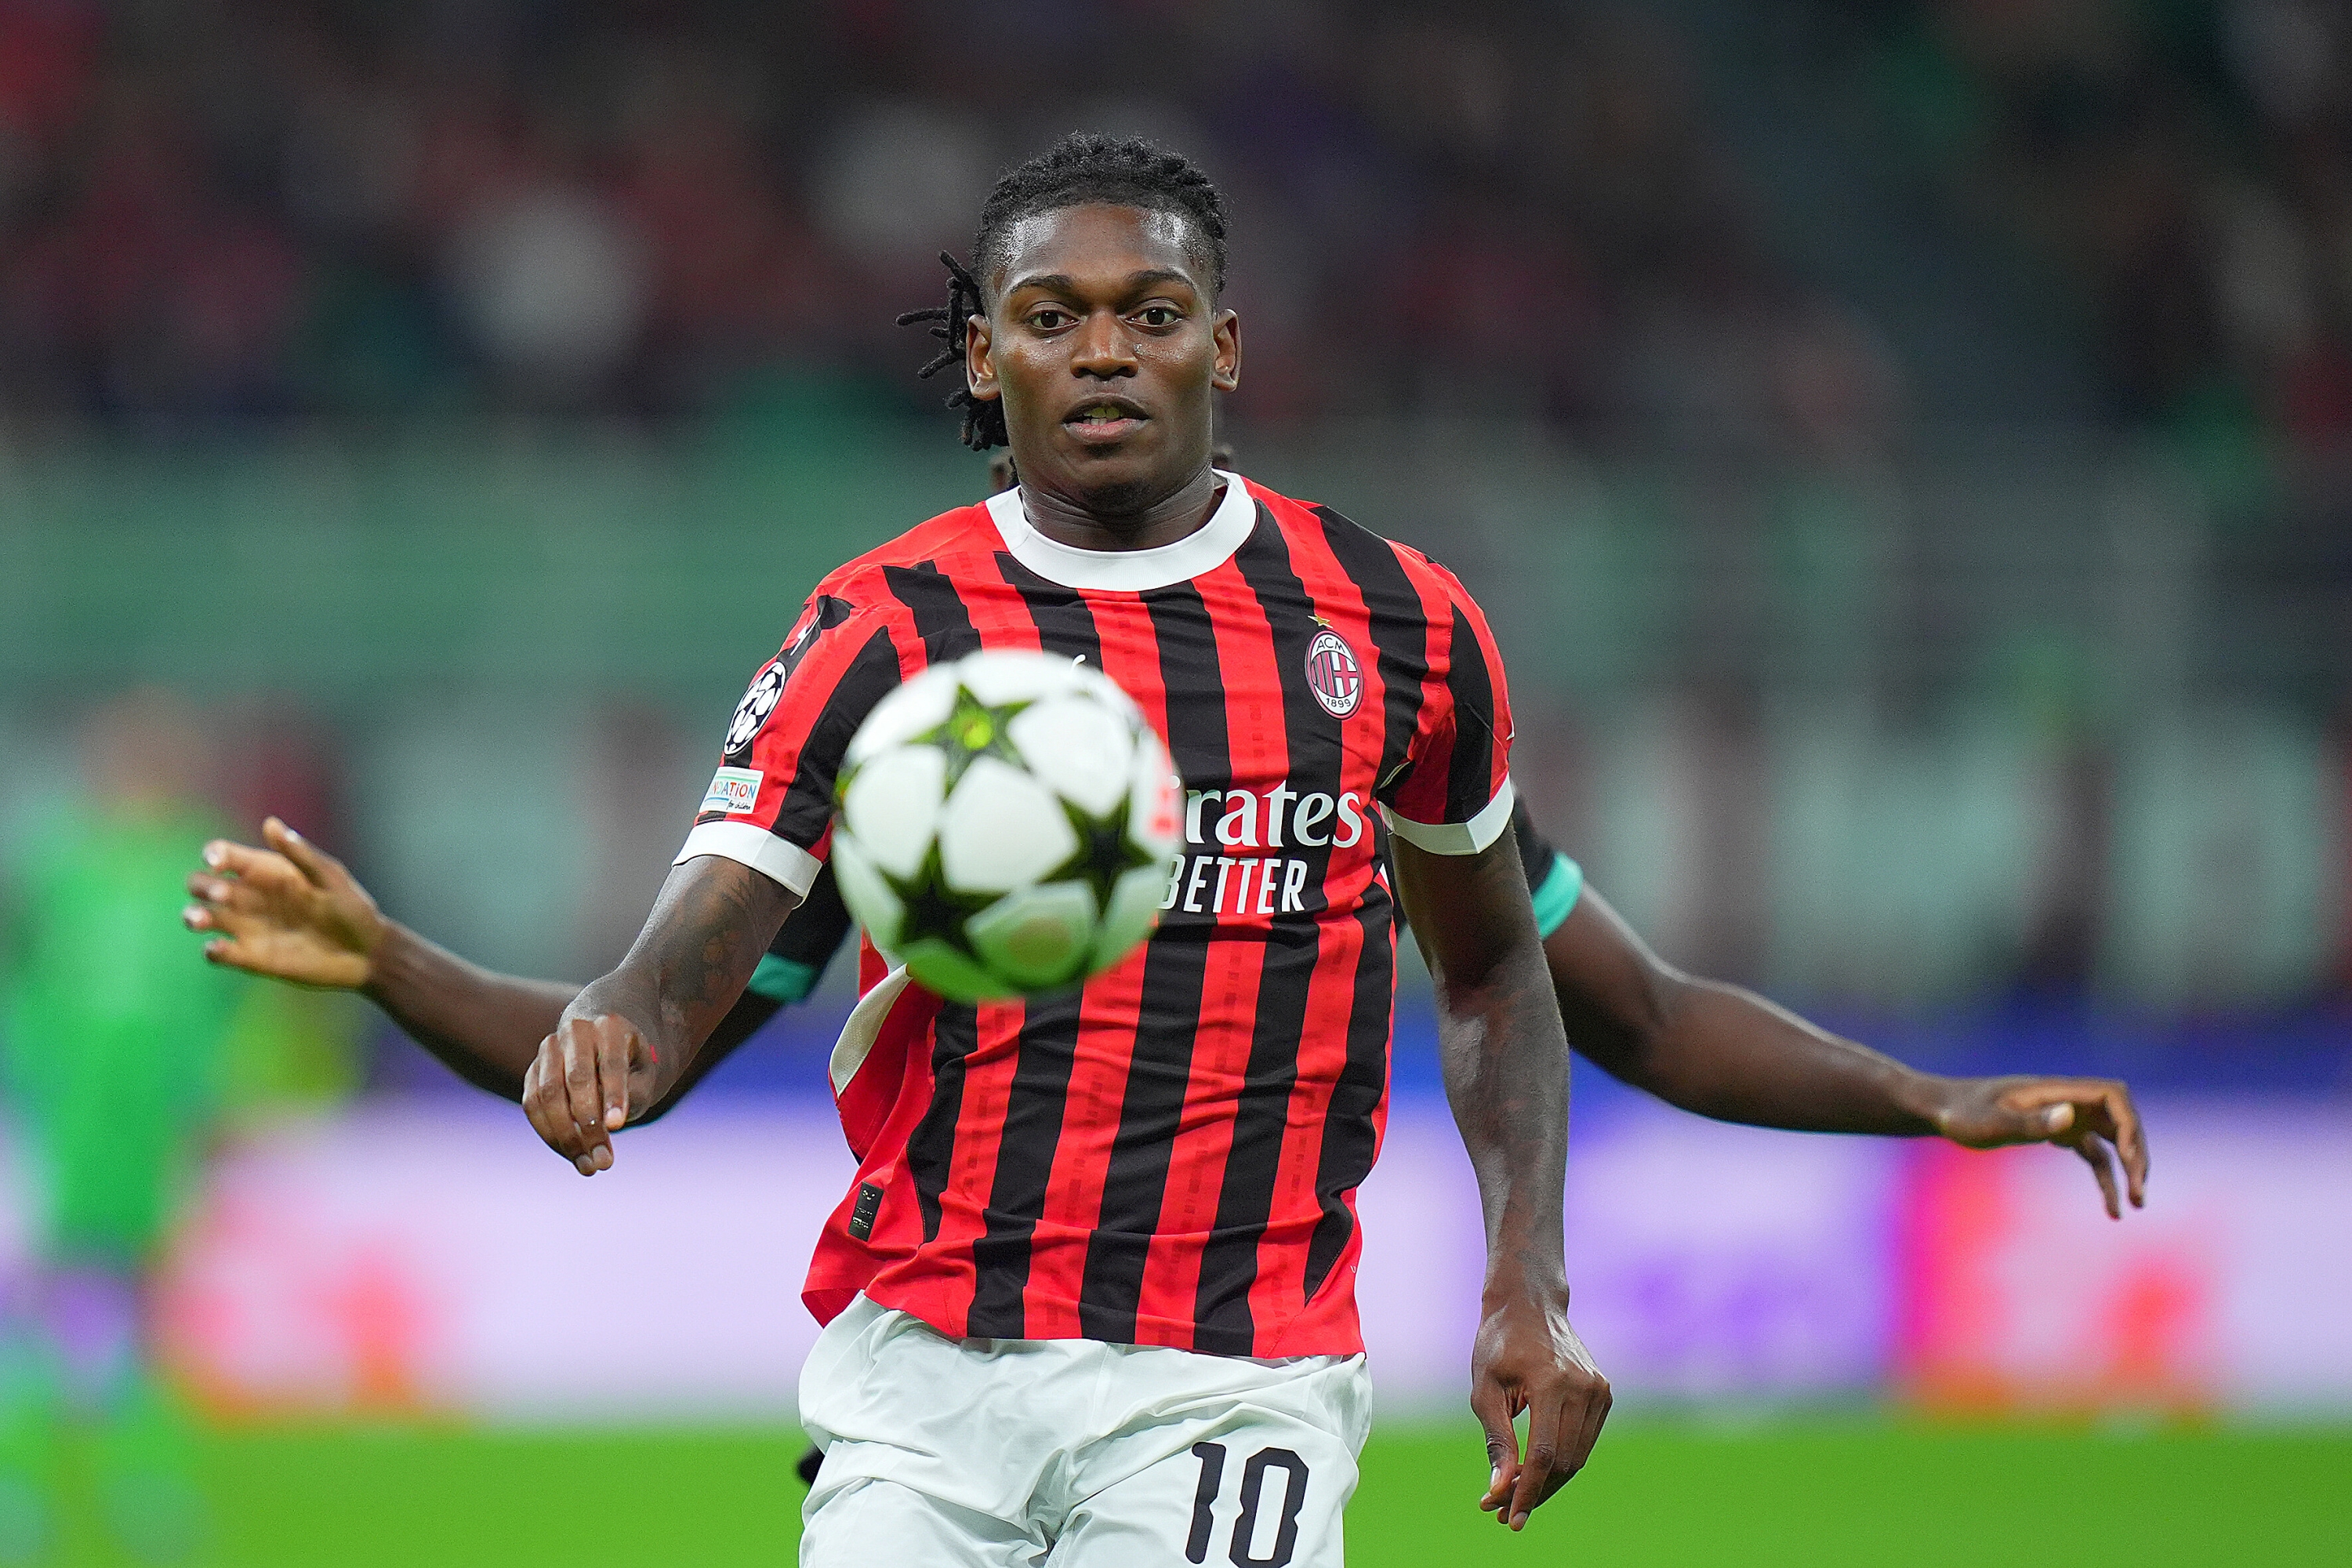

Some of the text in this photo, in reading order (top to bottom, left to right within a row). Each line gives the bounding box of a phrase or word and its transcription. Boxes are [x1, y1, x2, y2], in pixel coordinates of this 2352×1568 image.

[1316, 637, 1345, 653] ACM
[1326, 698, 1351, 708] 1899
[1170, 775, 1363, 848] rates
[1185, 1441, 1309, 1568] 10
